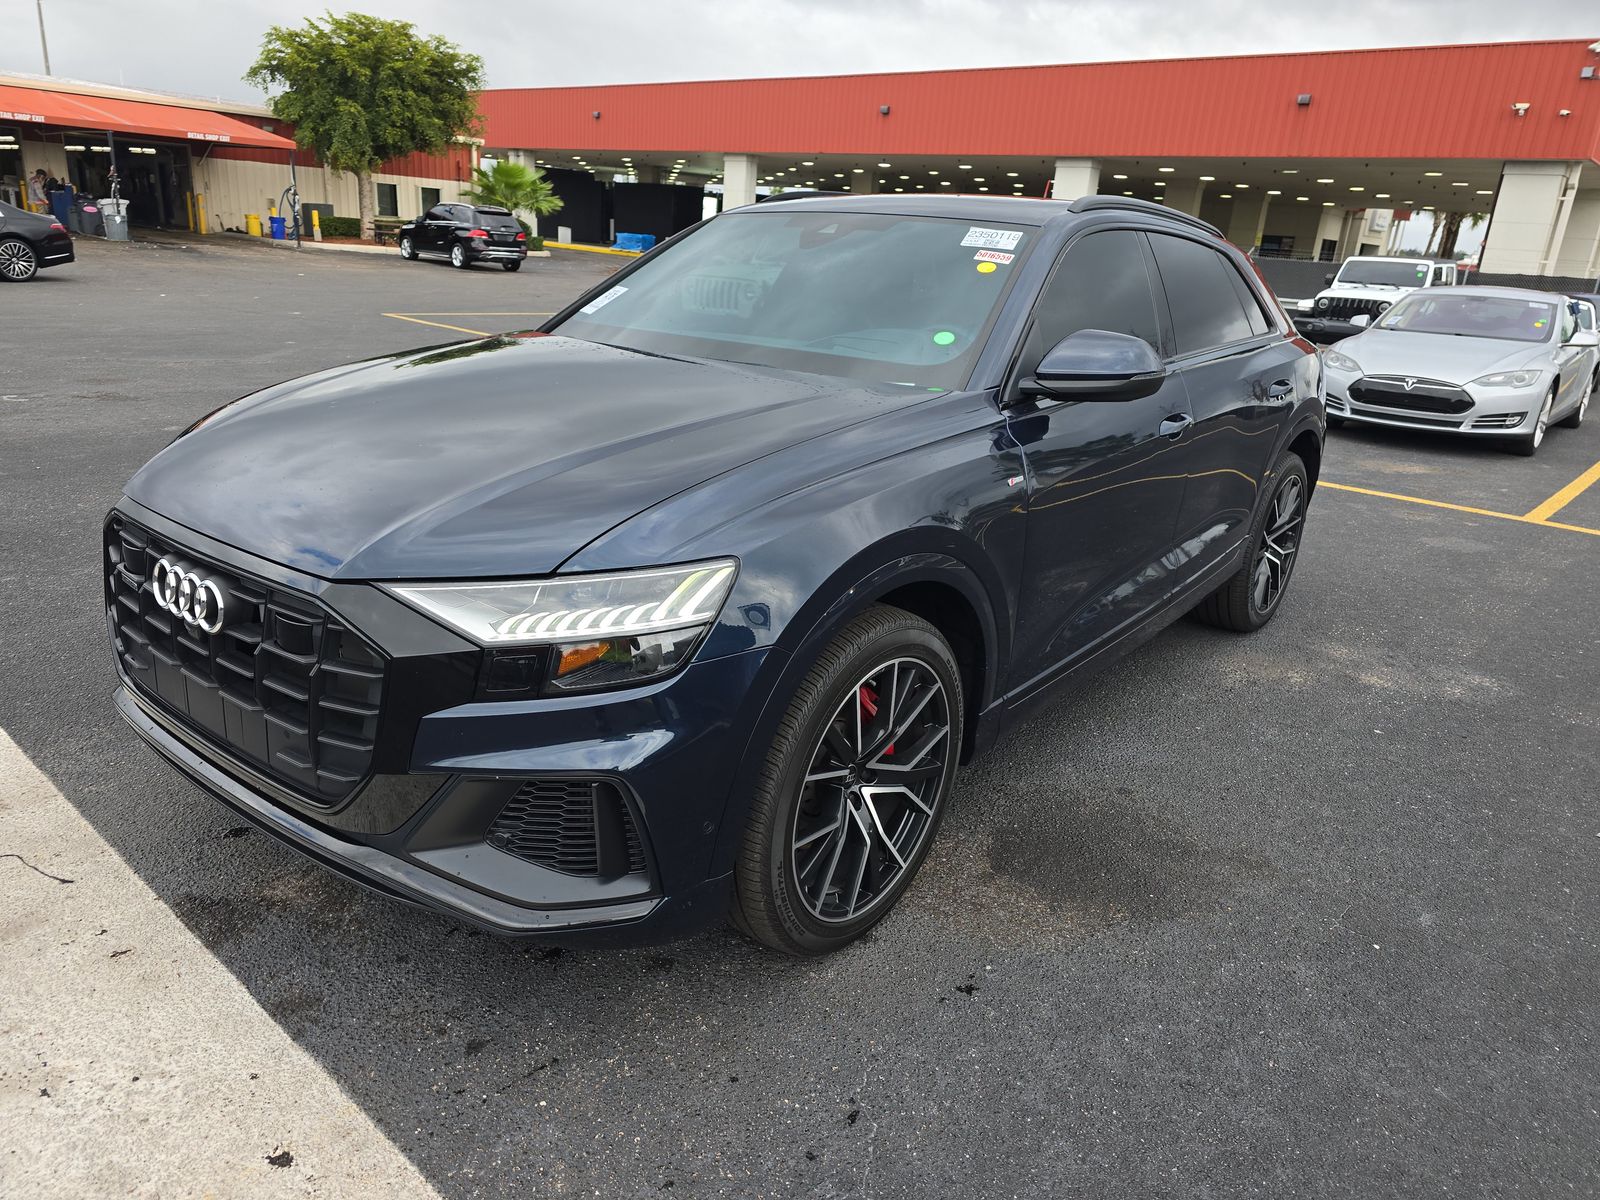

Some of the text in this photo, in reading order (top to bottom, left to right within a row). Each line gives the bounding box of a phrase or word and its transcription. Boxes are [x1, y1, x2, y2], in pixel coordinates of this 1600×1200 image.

[14, 113, 31, 121] SHOP
[31, 114, 45, 122] EXIT
[187, 131, 204, 139] DETAIL
[777, 860, 806, 935] CONTINENTAL
